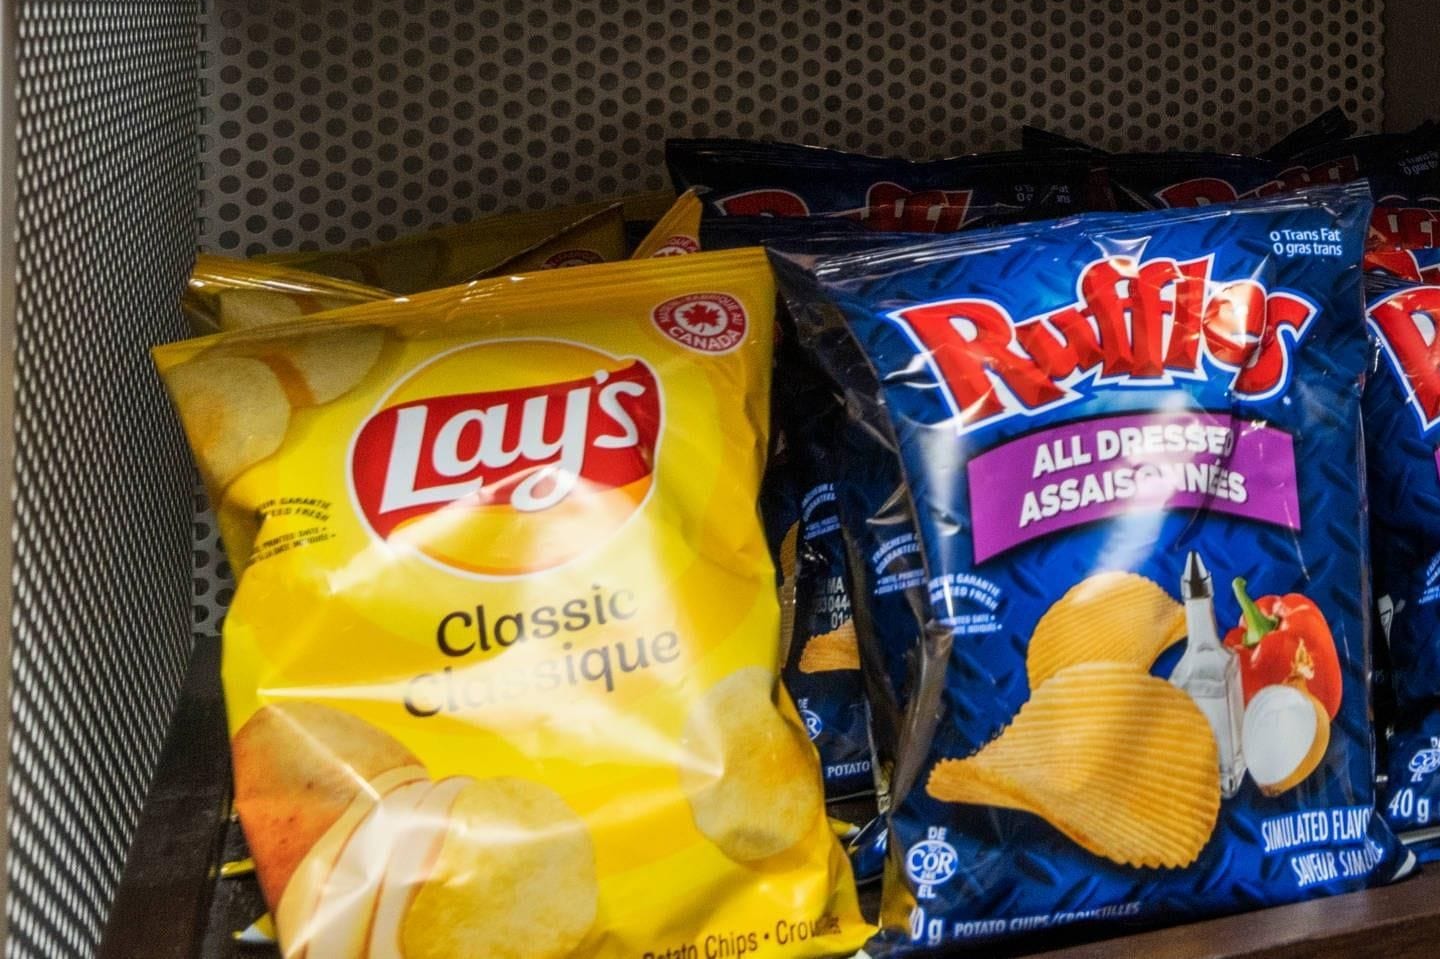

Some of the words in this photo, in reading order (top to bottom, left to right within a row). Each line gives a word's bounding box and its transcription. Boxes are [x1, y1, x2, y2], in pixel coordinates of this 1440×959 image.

[1281, 229, 1320, 241] Trans
[1320, 227, 1341, 242] Fat
[1286, 242, 1312, 257] gras
[1313, 242, 1343, 256] trans
[668, 326, 742, 350] CANADA
[892, 256, 1316, 424] Ruffles
[377, 368, 648, 515] Lay's
[1031, 439, 1092, 479] ALL
[1096, 424, 1237, 462] DRESSED
[435, 583, 640, 658] Classic
[827, 760, 871, 778] POTATO
[1388, 788, 1414, 817] 40
[1416, 797, 1430, 823] g
[927, 826, 947, 841] DE
[1261, 810, 1329, 853] SIMULATED
[1331, 806, 1375, 841] FLAVO
[908, 848, 953, 874] COR
[1290, 851, 1339, 888] SAVEUR
[704, 930, 759, 959] Chips
[928, 916, 944, 946] g
[954, 919, 1006, 938] POTATO
